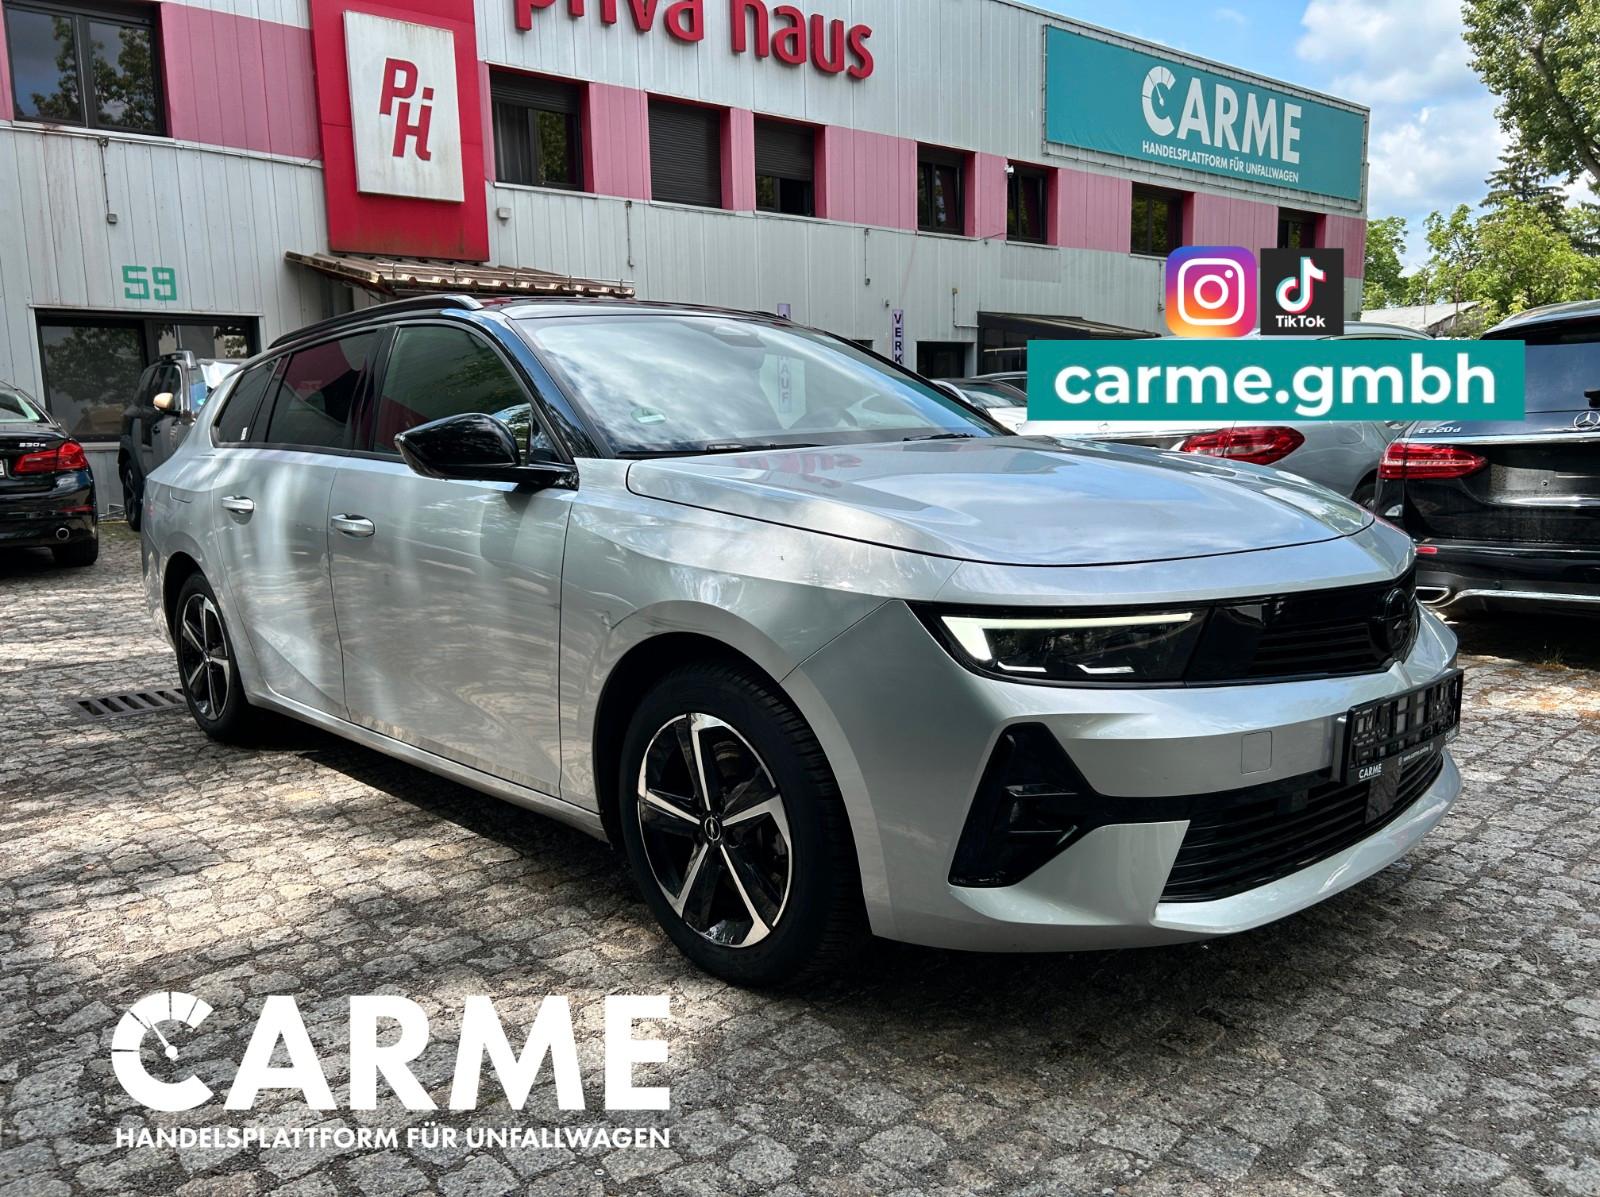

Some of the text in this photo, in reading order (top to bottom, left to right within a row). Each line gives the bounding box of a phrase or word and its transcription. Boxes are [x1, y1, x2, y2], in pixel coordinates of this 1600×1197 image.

[1142, 66, 1302, 164] CARME
[1142, 140, 1299, 184] HANDELSPLATTFORM FÜR UNFALLWAGEN
[121, 265, 177, 301] 59
[1358, 763, 1383, 779] CARME
